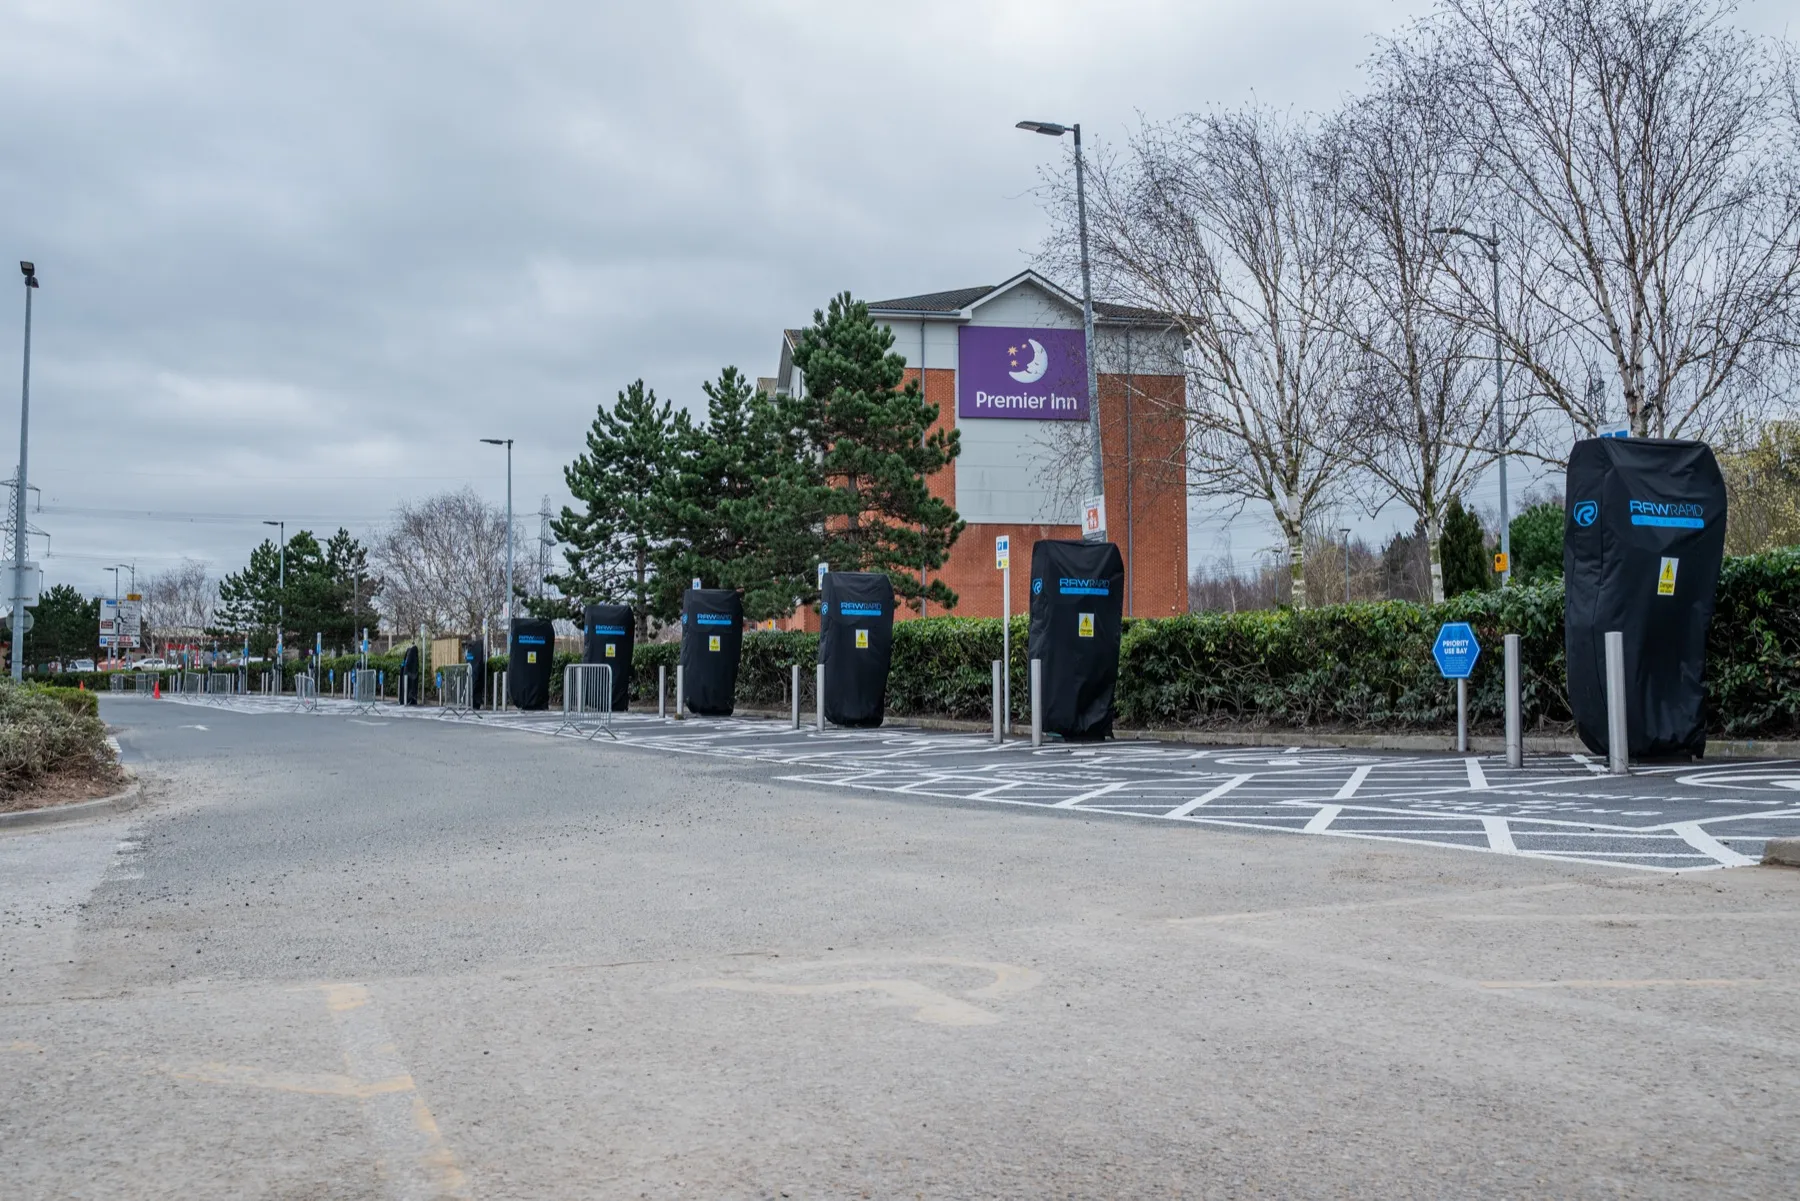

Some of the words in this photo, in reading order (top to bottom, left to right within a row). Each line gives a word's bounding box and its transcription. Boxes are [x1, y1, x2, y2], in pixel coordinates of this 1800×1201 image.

[976, 391, 1047, 409] Premier
[1051, 393, 1077, 410] Inn
[1629, 501, 1703, 517] RAWRAPID
[1059, 578, 1110, 588] RAWRAPID
